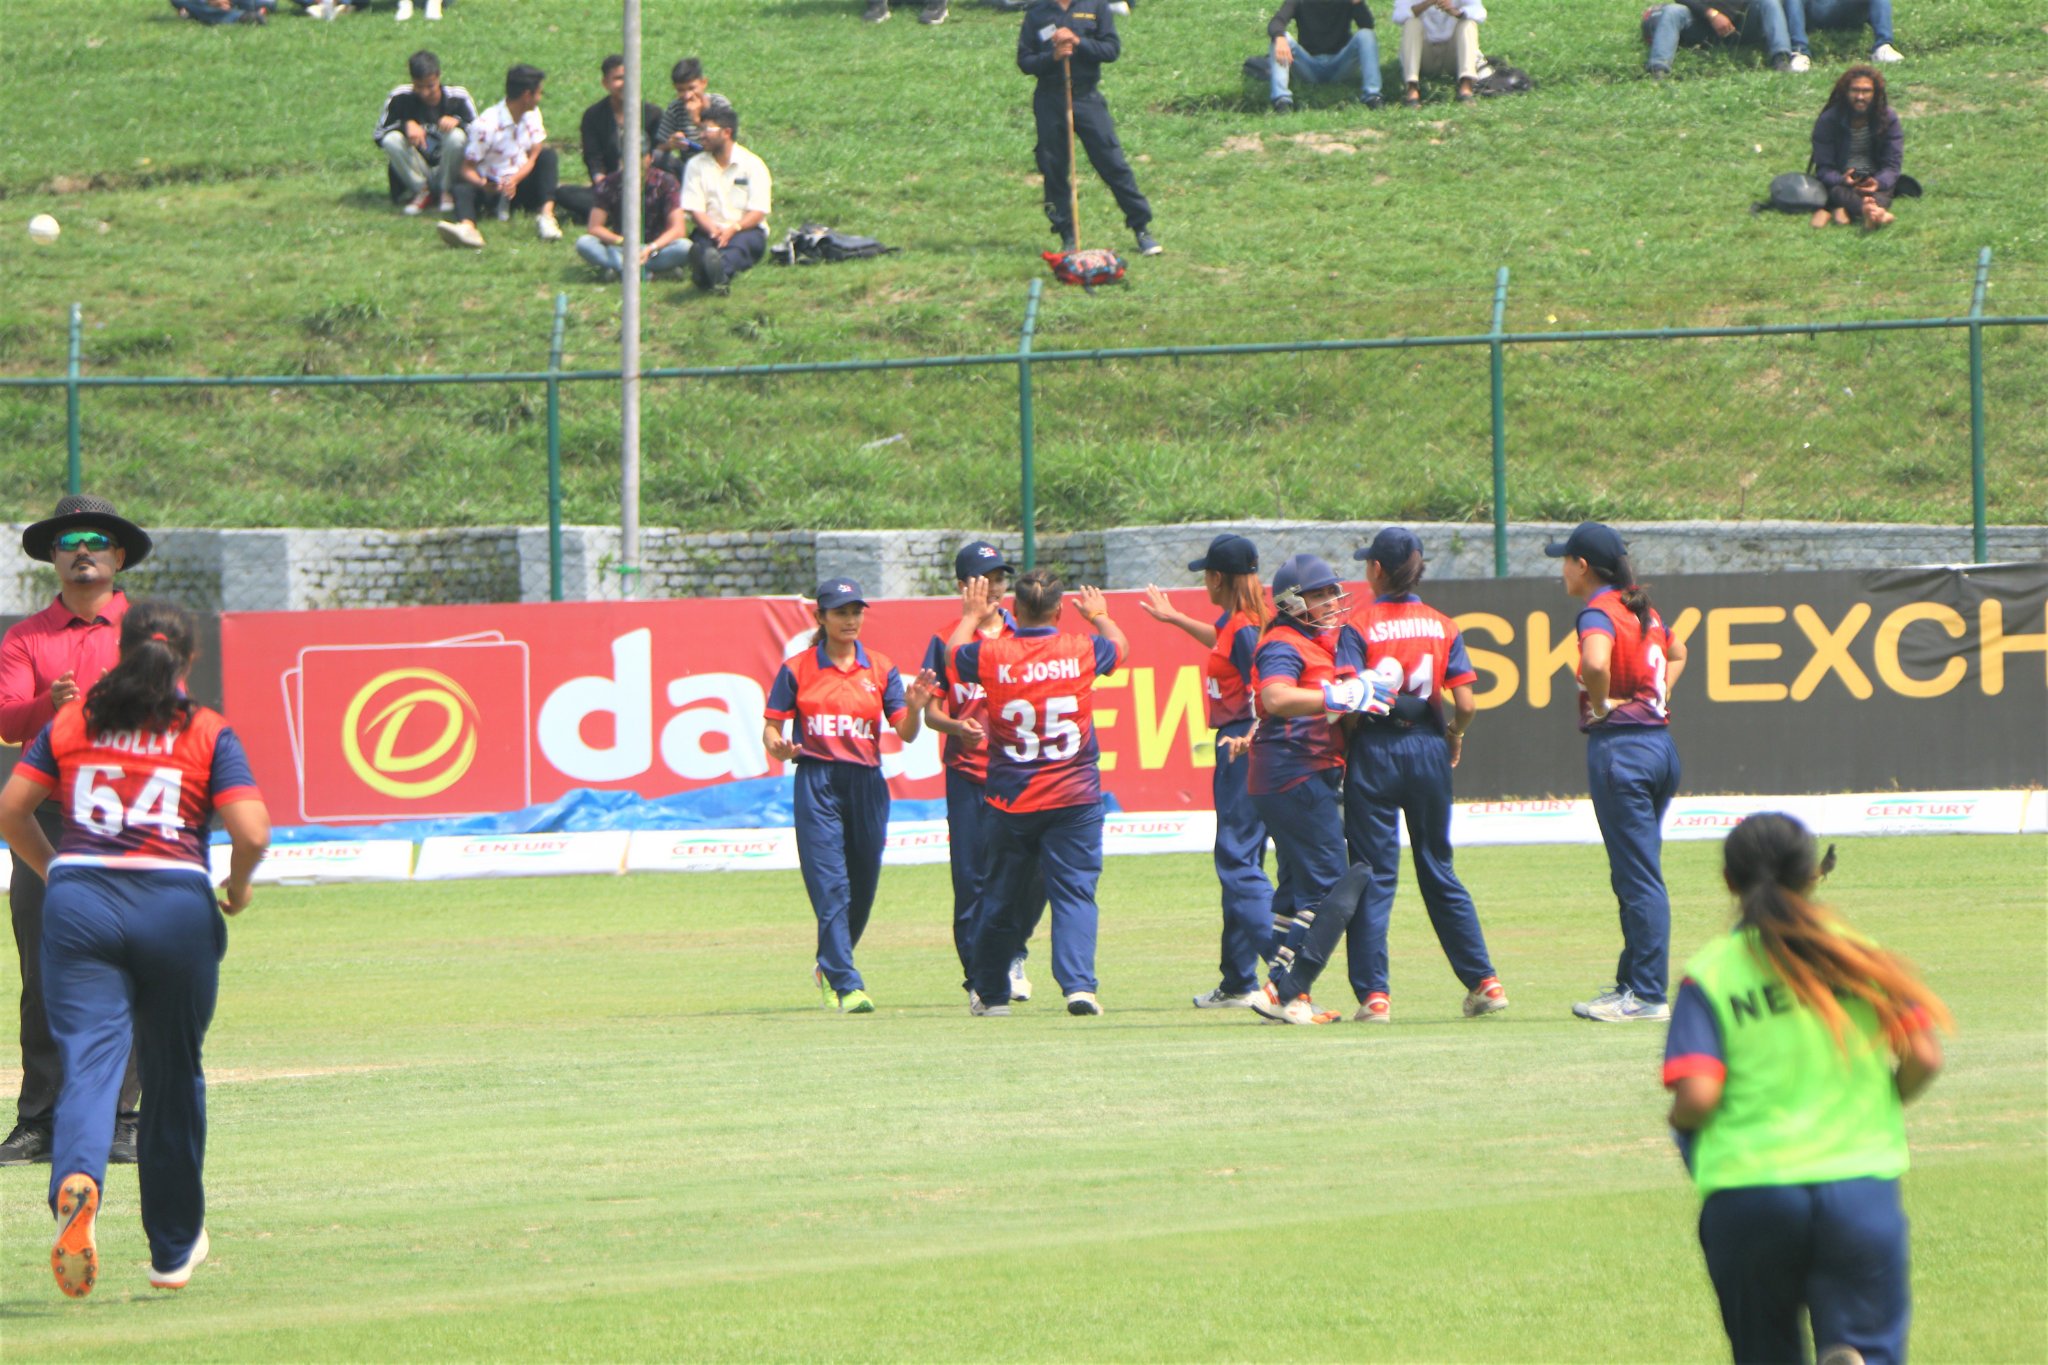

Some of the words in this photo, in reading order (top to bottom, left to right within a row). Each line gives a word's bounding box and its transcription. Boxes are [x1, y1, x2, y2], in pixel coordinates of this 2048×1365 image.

[1369, 618, 1445, 642] ASHMINA
[1440, 598, 2048, 709] SKEXCH
[999, 664, 1017, 683] K.
[1022, 658, 1081, 683] JOSHI
[807, 714, 874, 739] NEPAL
[1002, 695, 1081, 762] 35
[93, 730, 181, 755] DOLLY
[74, 765, 185, 840] 64
[1468, 800, 1577, 814] CENTURY
[1866, 804, 1976, 816] CENTURY
[1109, 823, 1185, 833] NTURY
[463, 842, 569, 853] CENTURY
[672, 842, 778, 855] CENTURY
[885, 834, 950, 847] CENT
